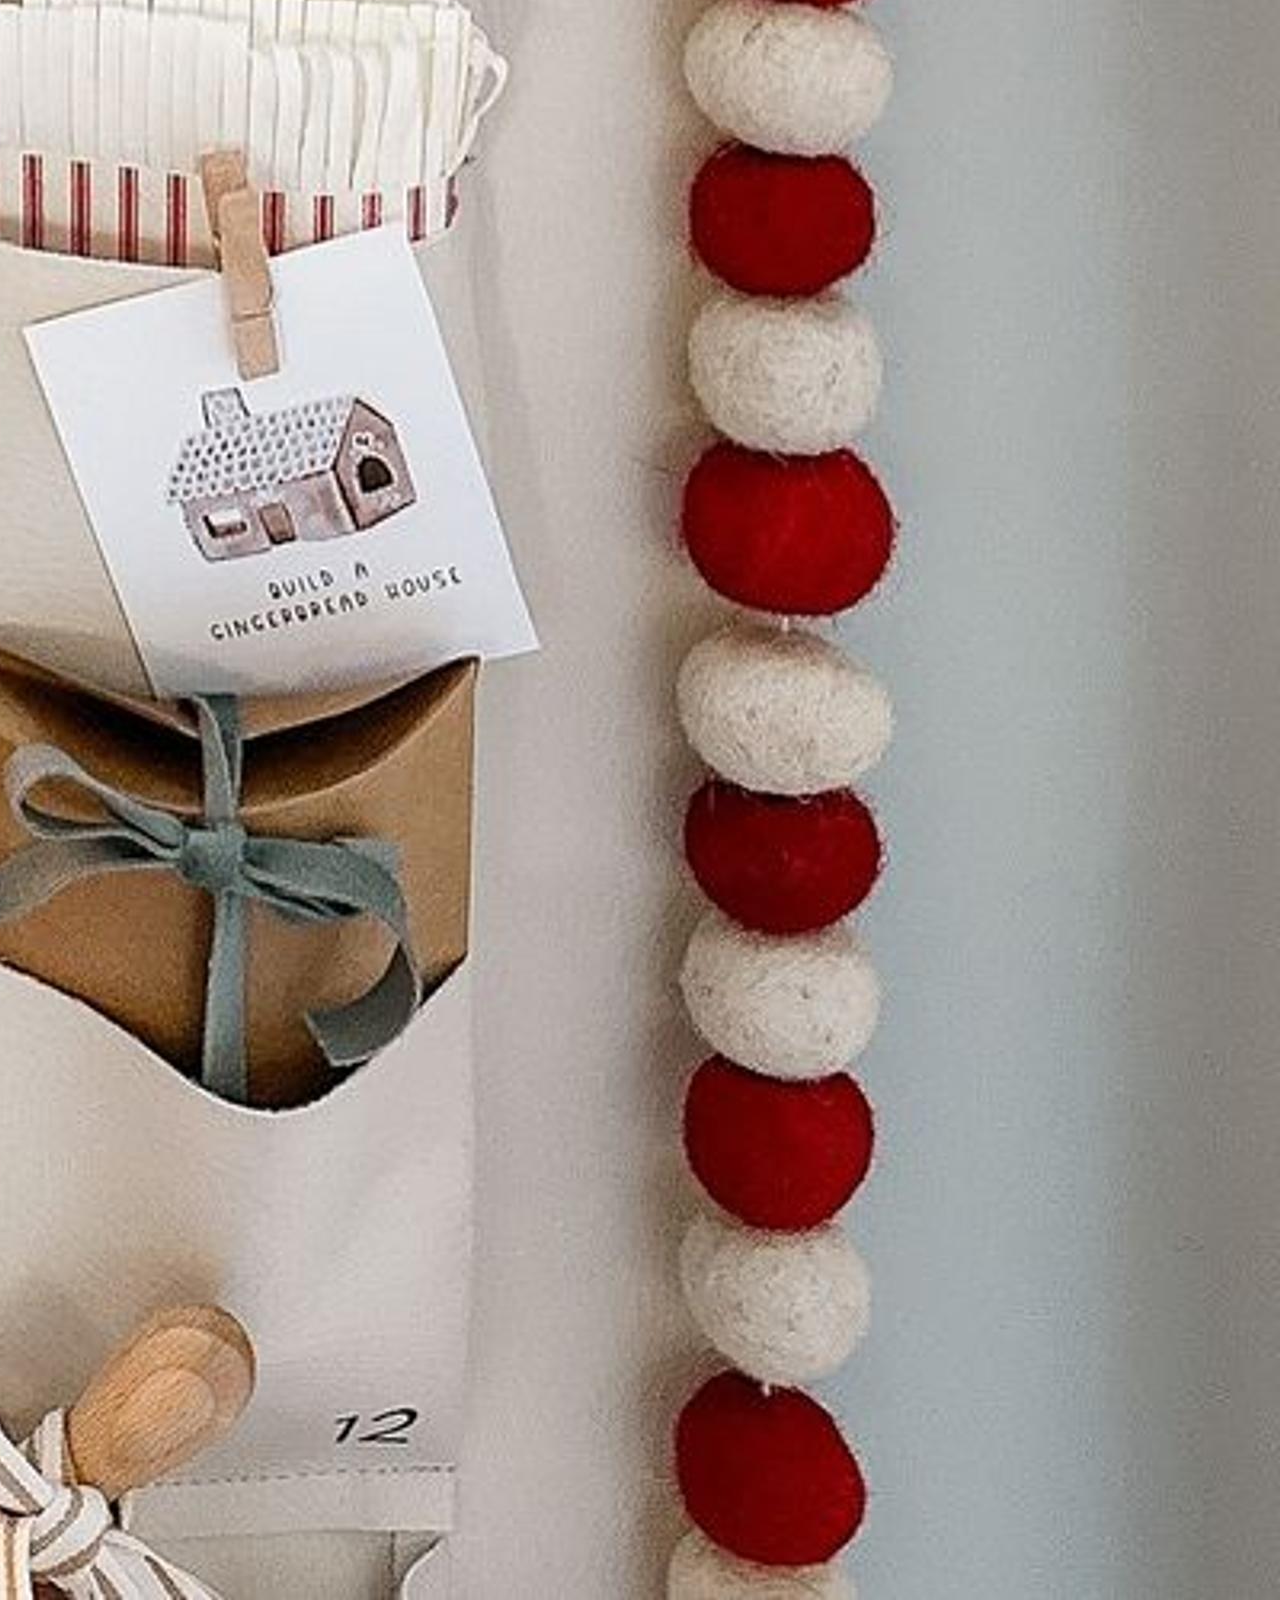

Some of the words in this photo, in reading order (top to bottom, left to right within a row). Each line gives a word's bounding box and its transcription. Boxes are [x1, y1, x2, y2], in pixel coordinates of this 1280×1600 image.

[268, 569, 334, 599] BUILD
[354, 562, 369, 579] A
[210, 590, 369, 640] GINGERBREAD
[385, 566, 462, 600] HOUSE
[335, 1407, 418, 1445] 12
